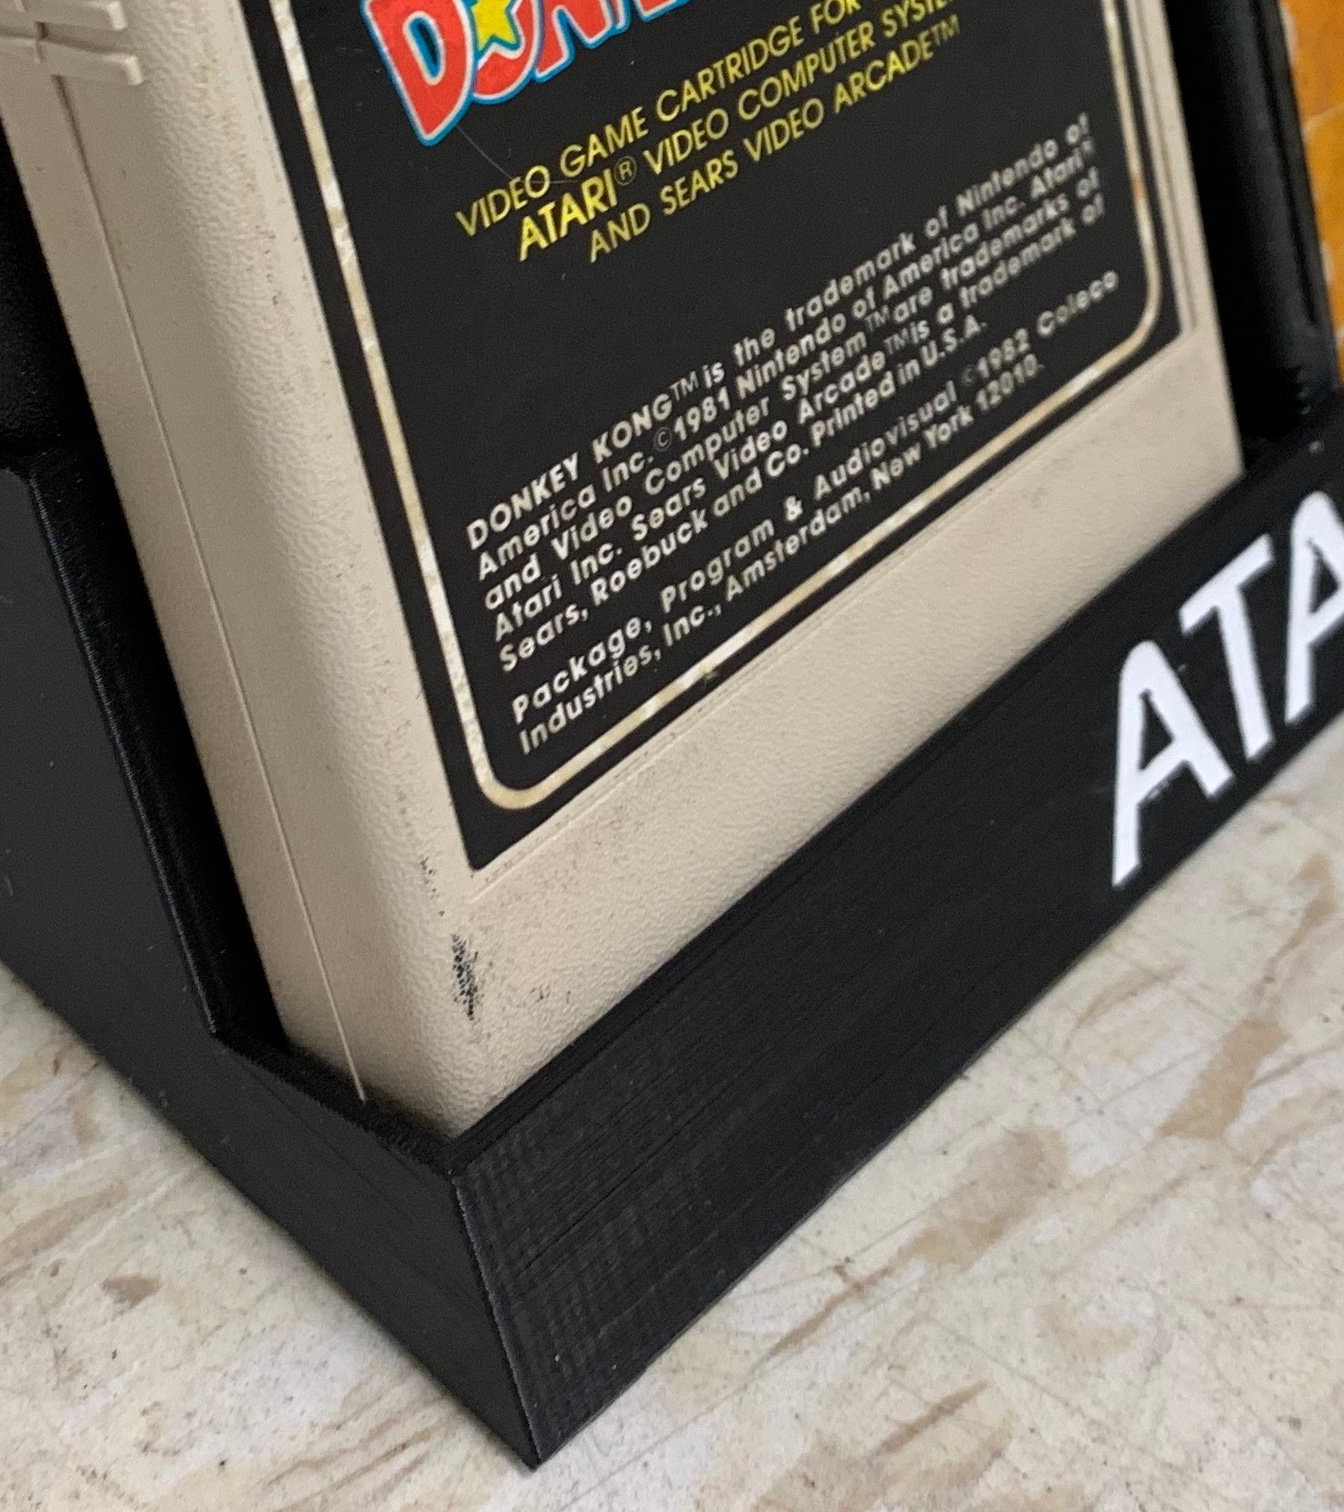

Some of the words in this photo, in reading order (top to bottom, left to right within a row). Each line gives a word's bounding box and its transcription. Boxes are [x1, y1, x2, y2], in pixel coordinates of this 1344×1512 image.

[456, 165, 551, 236] VIDEO
[560, 106, 648, 177] GAME
[656, 16, 804, 121] CARTRIDGE
[590, 203, 650, 263] AND
[660, 149, 738, 215] SEARS
[742, 98, 824, 162] VIDEO
[643, 108, 728, 175] VIDEO
[738, 21, 876, 120] COMPUTER
[467, 452, 578, 550] DONKEY
[703, 362, 724, 388] is
[733, 328, 775, 367] the
[784, 232, 916, 332] trademark
[925, 205, 948, 239] of
[956, 139, 1058, 217] Nintendo
[1065, 113, 1088, 145] of
[479, 484, 596, 580] America
[601, 452, 653, 492] Inc.
[735, 313, 846, 399] Nintendo
[852, 286, 876, 319] of
[883, 223, 979, 302] America
[981, 196, 1026, 231] Inc.
[485, 552, 541, 610] and
[551, 496, 632, 560] Video
[644, 397, 769, 495] Computer
[893, 287, 933, 324] are
[940, 193, 1069, 292] trademarks
[1076, 166, 1100, 199] of
[496, 574, 562, 642] Atari
[570, 543, 622, 585] Inc.
[631, 478, 706, 541] Sears
[712, 420, 787, 480] Video
[910, 320, 930, 344] is
[937, 303, 954, 325] a
[959, 216, 1076, 309] trademark
[1080, 193, 1104, 226] of
[500, 604, 588, 672] Sears,
[590, 509, 708, 606] Roebuck
[712, 466, 762, 517] and
[765, 444, 809, 477] Co.
[810, 371, 895, 447] Printed
[897, 359, 920, 385] in
[920, 314, 986, 367] U.S.A.
[512, 617, 652, 724] Package,
[660, 519, 774, 613] Program
[784, 496, 803, 522] &
[814, 380, 957, 500] Audiovisual
[520, 645, 661, 754] Industries,
[870, 443, 920, 490] New
[923, 405, 974, 448] York
